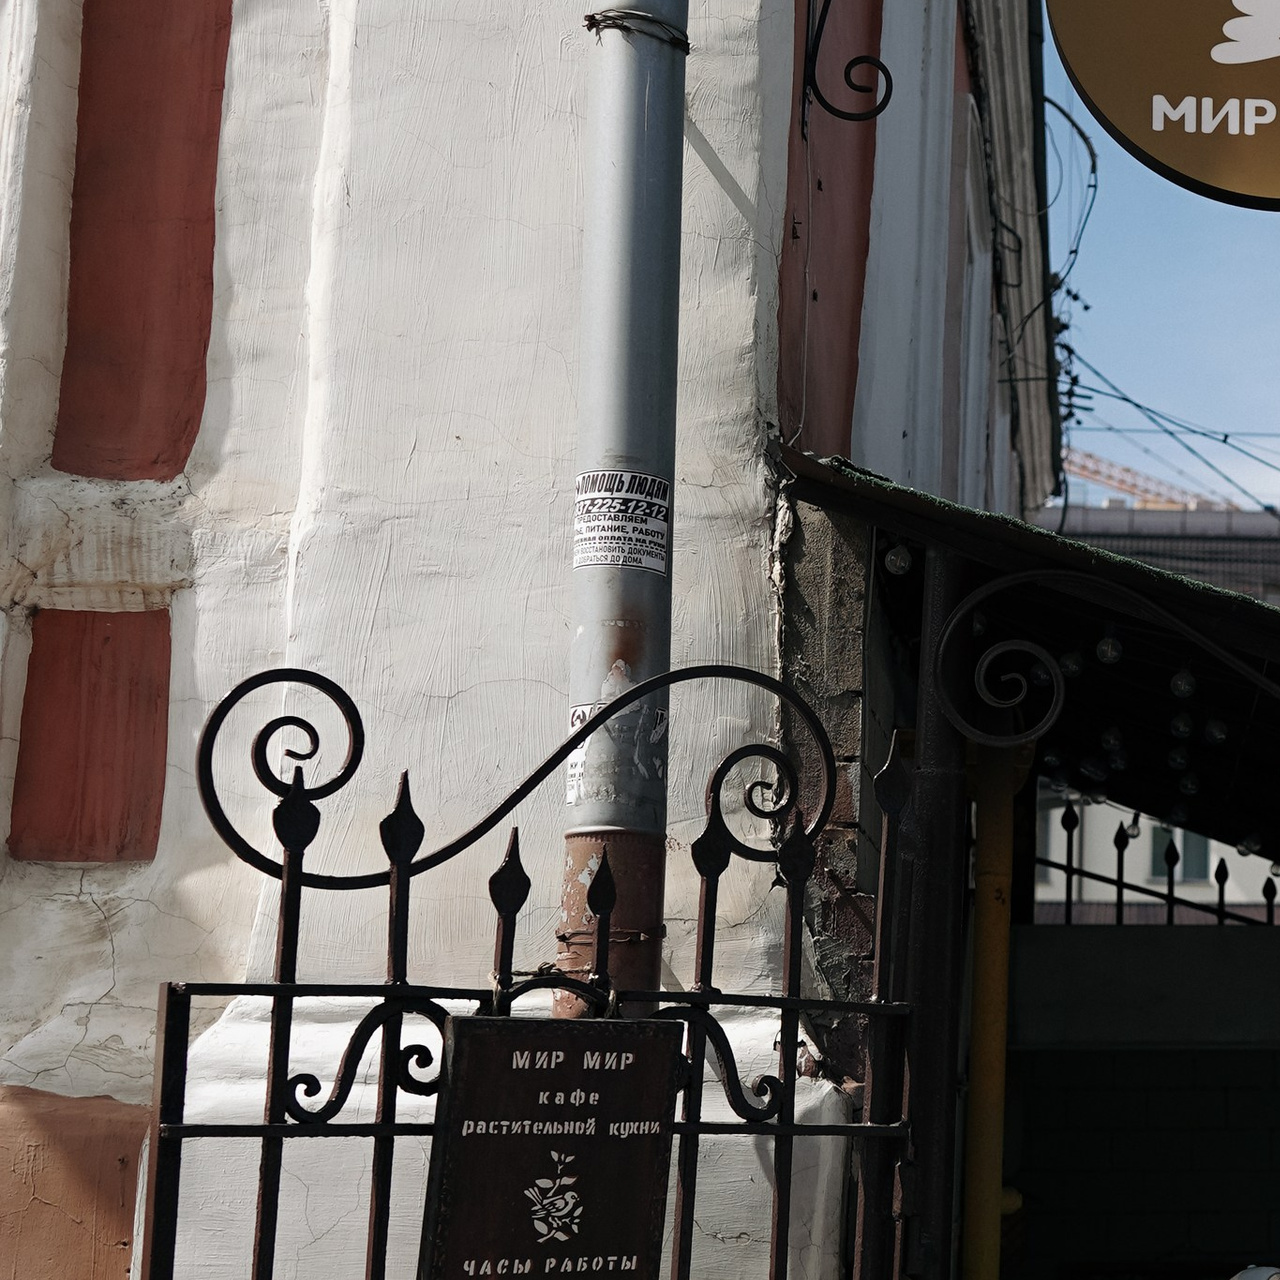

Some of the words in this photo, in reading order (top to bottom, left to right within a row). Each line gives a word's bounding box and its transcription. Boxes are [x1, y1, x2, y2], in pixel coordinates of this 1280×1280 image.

[1151, 94, 1278, 136] МИР
[626, 475, 668, 501] ЛЮДЯМ
[632, 527, 665, 540] РАБОТУ
[512, 1050, 566, 1070] МИР
[583, 1050, 635, 1070] МИР
[538, 1088, 601, 1107] кафе
[461, 1117, 597, 1137] растительной
[609, 1120, 660, 1139] кухни
[463, 1258, 532, 1276] ЧАСЫ
[544, 1255, 638, 1274] РАБОТЫ
